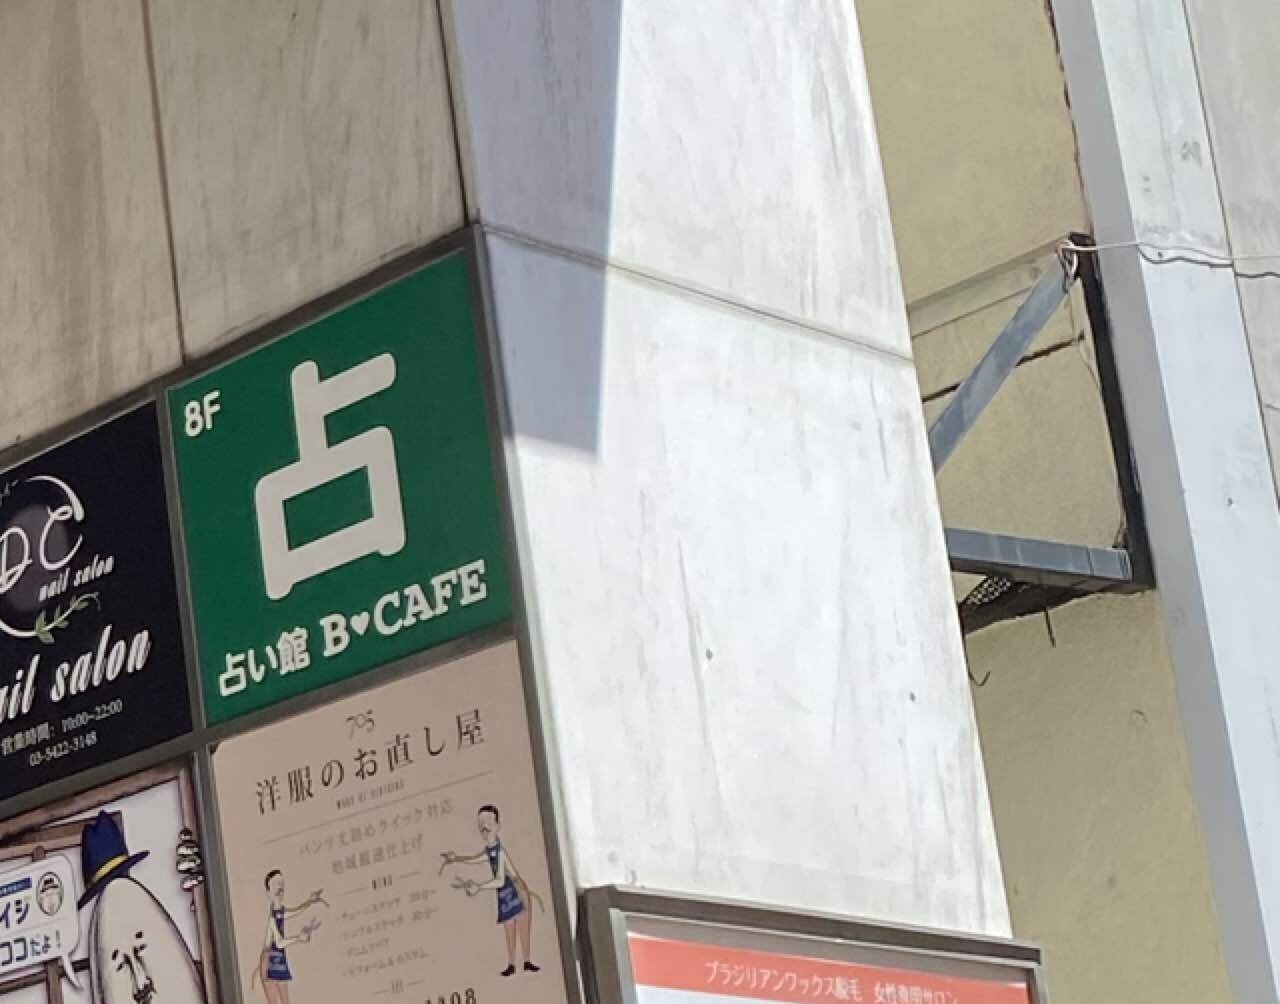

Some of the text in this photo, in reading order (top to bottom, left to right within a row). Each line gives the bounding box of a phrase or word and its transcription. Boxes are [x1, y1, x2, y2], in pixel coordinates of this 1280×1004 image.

[183, 390, 221, 437] 8F
[254, 352, 406, 601] 占
[51, 624, 152, 702] salon
[218, 627, 311, 697] 占い館
[255, 708, 486, 817] 洋服のお直し屋
[705, 959, 862, 1004] ブラジリアンワックス脱毛
